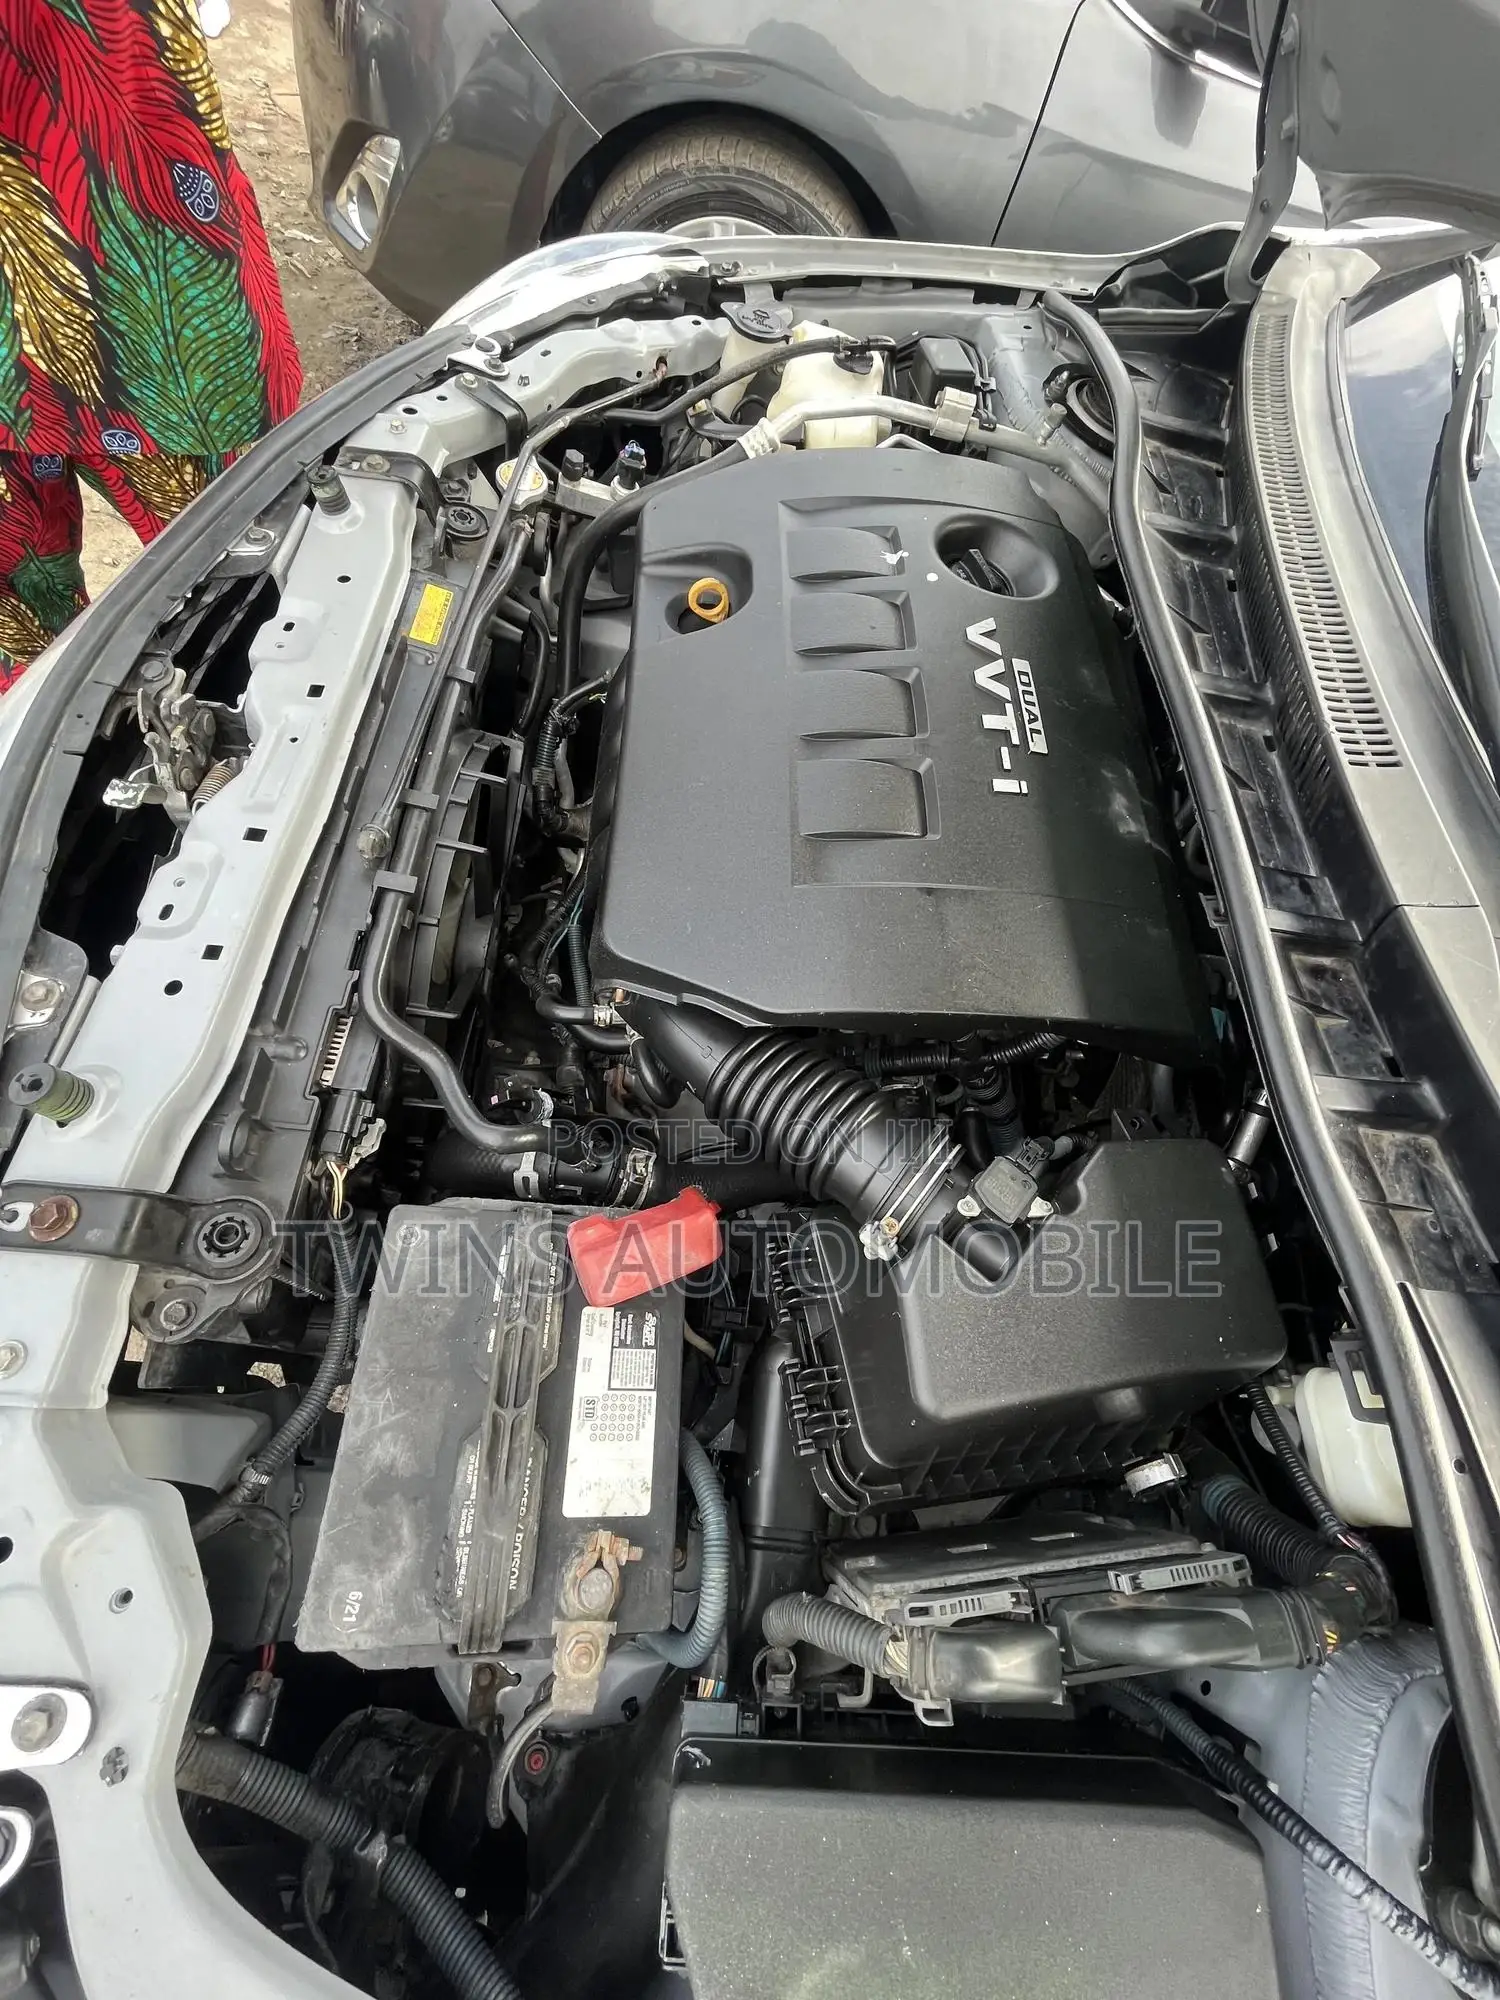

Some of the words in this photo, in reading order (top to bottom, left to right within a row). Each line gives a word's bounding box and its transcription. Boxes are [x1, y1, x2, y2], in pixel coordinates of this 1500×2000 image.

[965, 617, 1029, 794] VVT-i
[1016, 669, 1043, 744] DUAL
[584, 1398, 596, 1419] STD
[342, 1591, 363, 1622] 6/21
